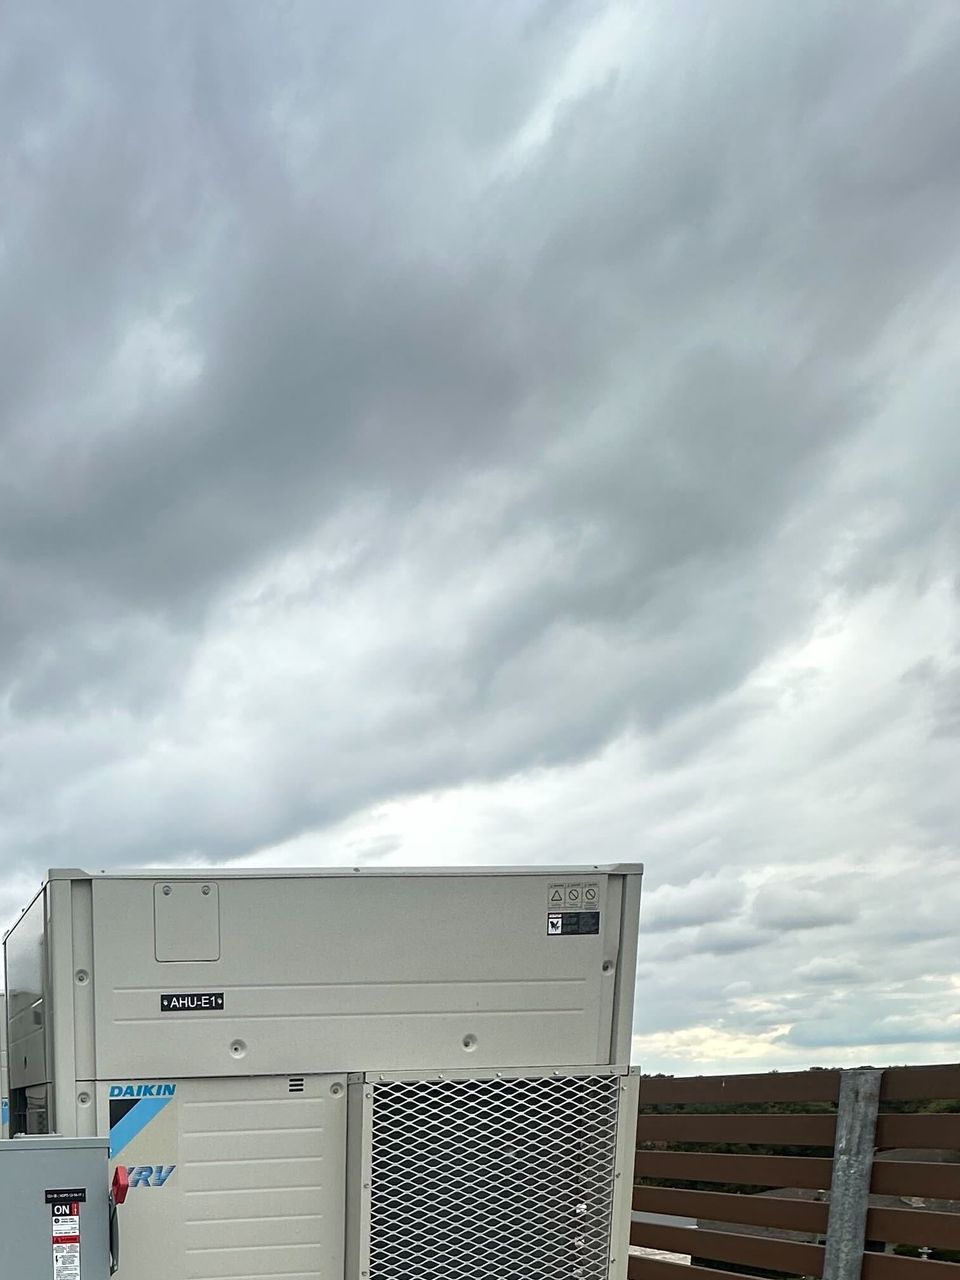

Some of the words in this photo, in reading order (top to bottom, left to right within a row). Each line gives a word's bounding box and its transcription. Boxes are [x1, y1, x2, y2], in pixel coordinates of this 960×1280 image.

[170, 996, 216, 1008] AHU-E1
[109, 1084, 177, 1097] DAIKIN
[54, 1205, 70, 1215] ON
